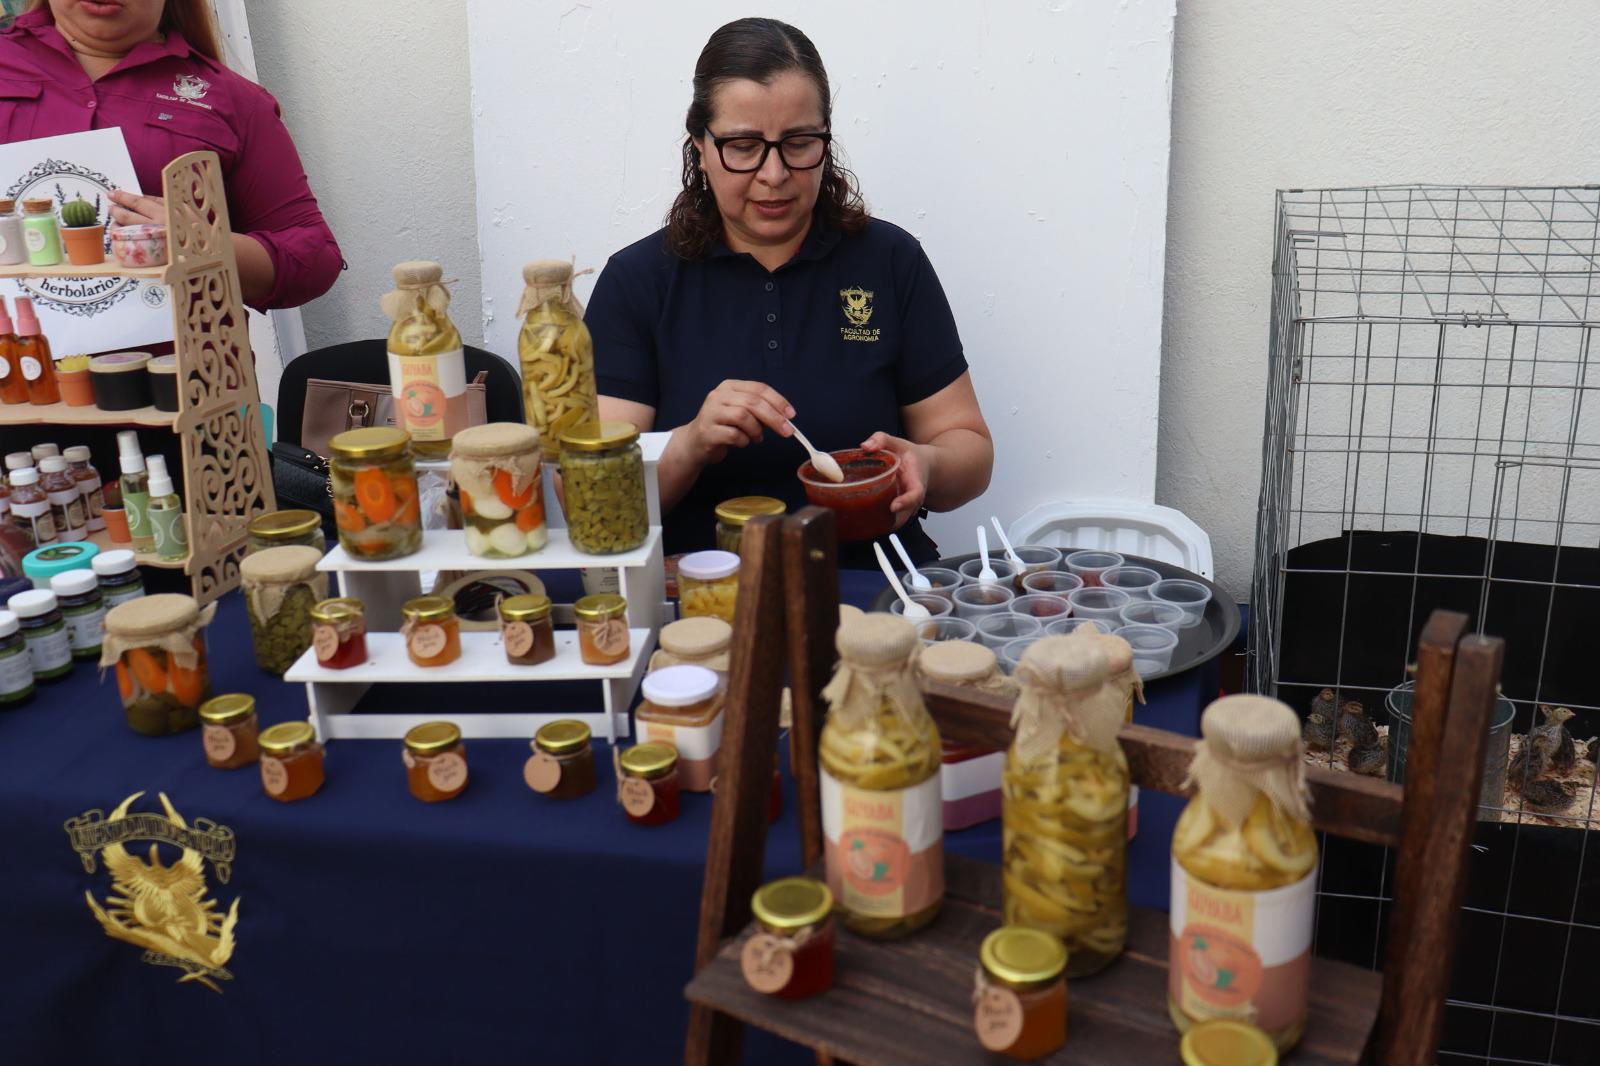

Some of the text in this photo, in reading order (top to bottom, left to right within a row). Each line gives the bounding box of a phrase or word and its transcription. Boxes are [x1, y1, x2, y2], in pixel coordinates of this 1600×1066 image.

[40, 276, 122, 298] herbolarios
[840, 327, 881, 336] FACULTAD DE
